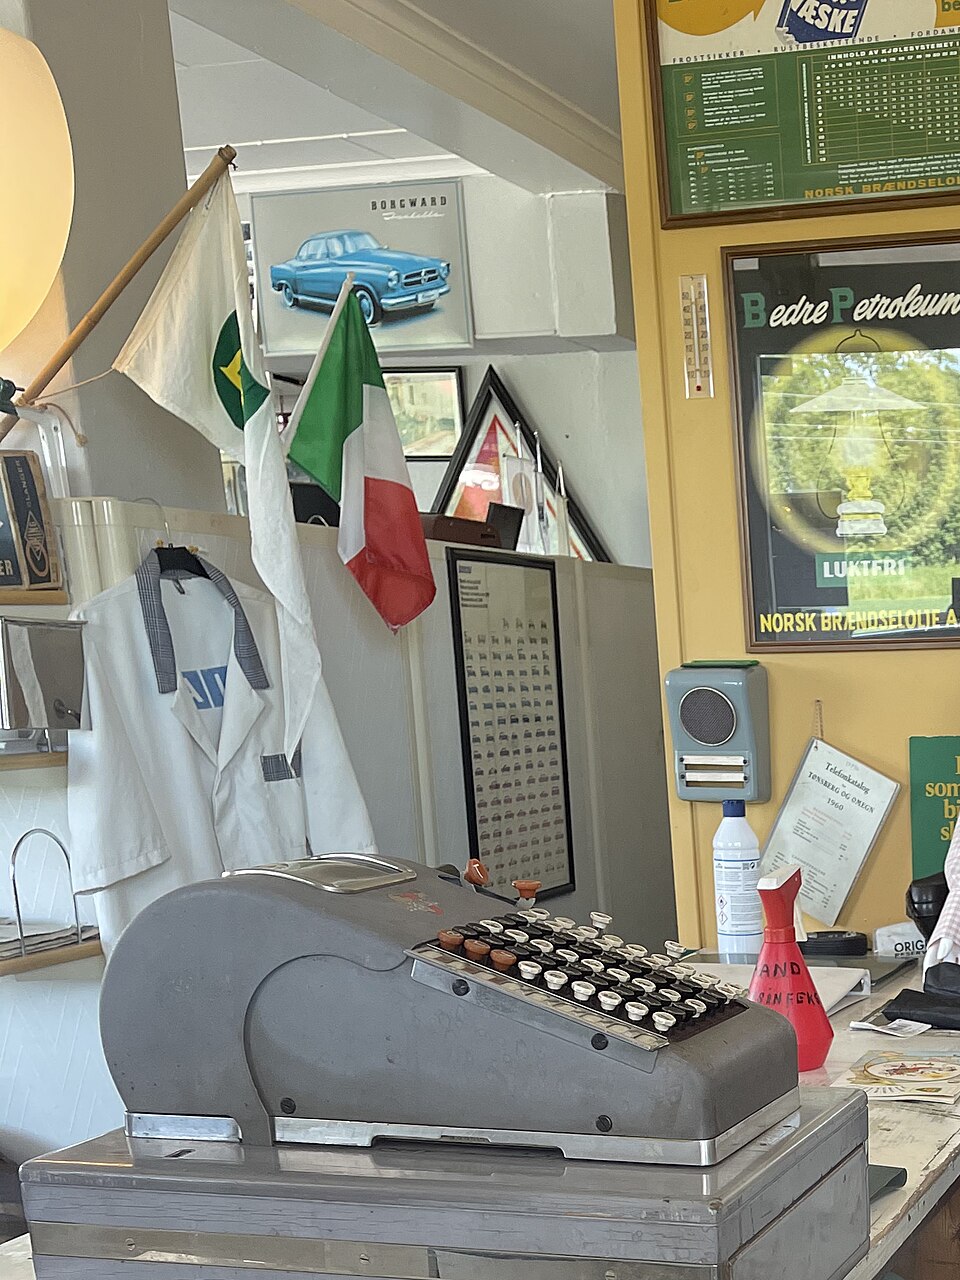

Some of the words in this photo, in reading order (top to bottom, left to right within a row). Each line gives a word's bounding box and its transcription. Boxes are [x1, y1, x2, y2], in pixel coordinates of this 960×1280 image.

[773, 35, 880, 53] RUSTBESKYTTENDE
[672, 50, 745, 64] FROSTSIKKER
[827, 50, 866, 60] INNHOLD
[868, 48, 879, 56] AV
[804, 186, 855, 200] NORSK
[371, 196, 448, 211] BORGWARD
[740, 291, 829, 328] Bedre
[822, 558, 906, 578] LUKTFRI
[759, 611, 817, 633] NORSK
[820, 608, 940, 632] BRÆNDSELOLJE
[825, 761, 871, 795] Telefonkatalog
[808, 771, 840, 794] TØNSBERG
[840, 790, 851, 800] OG
[851, 797, 875, 814] OMEGN
[827, 798, 844, 811] 1960
